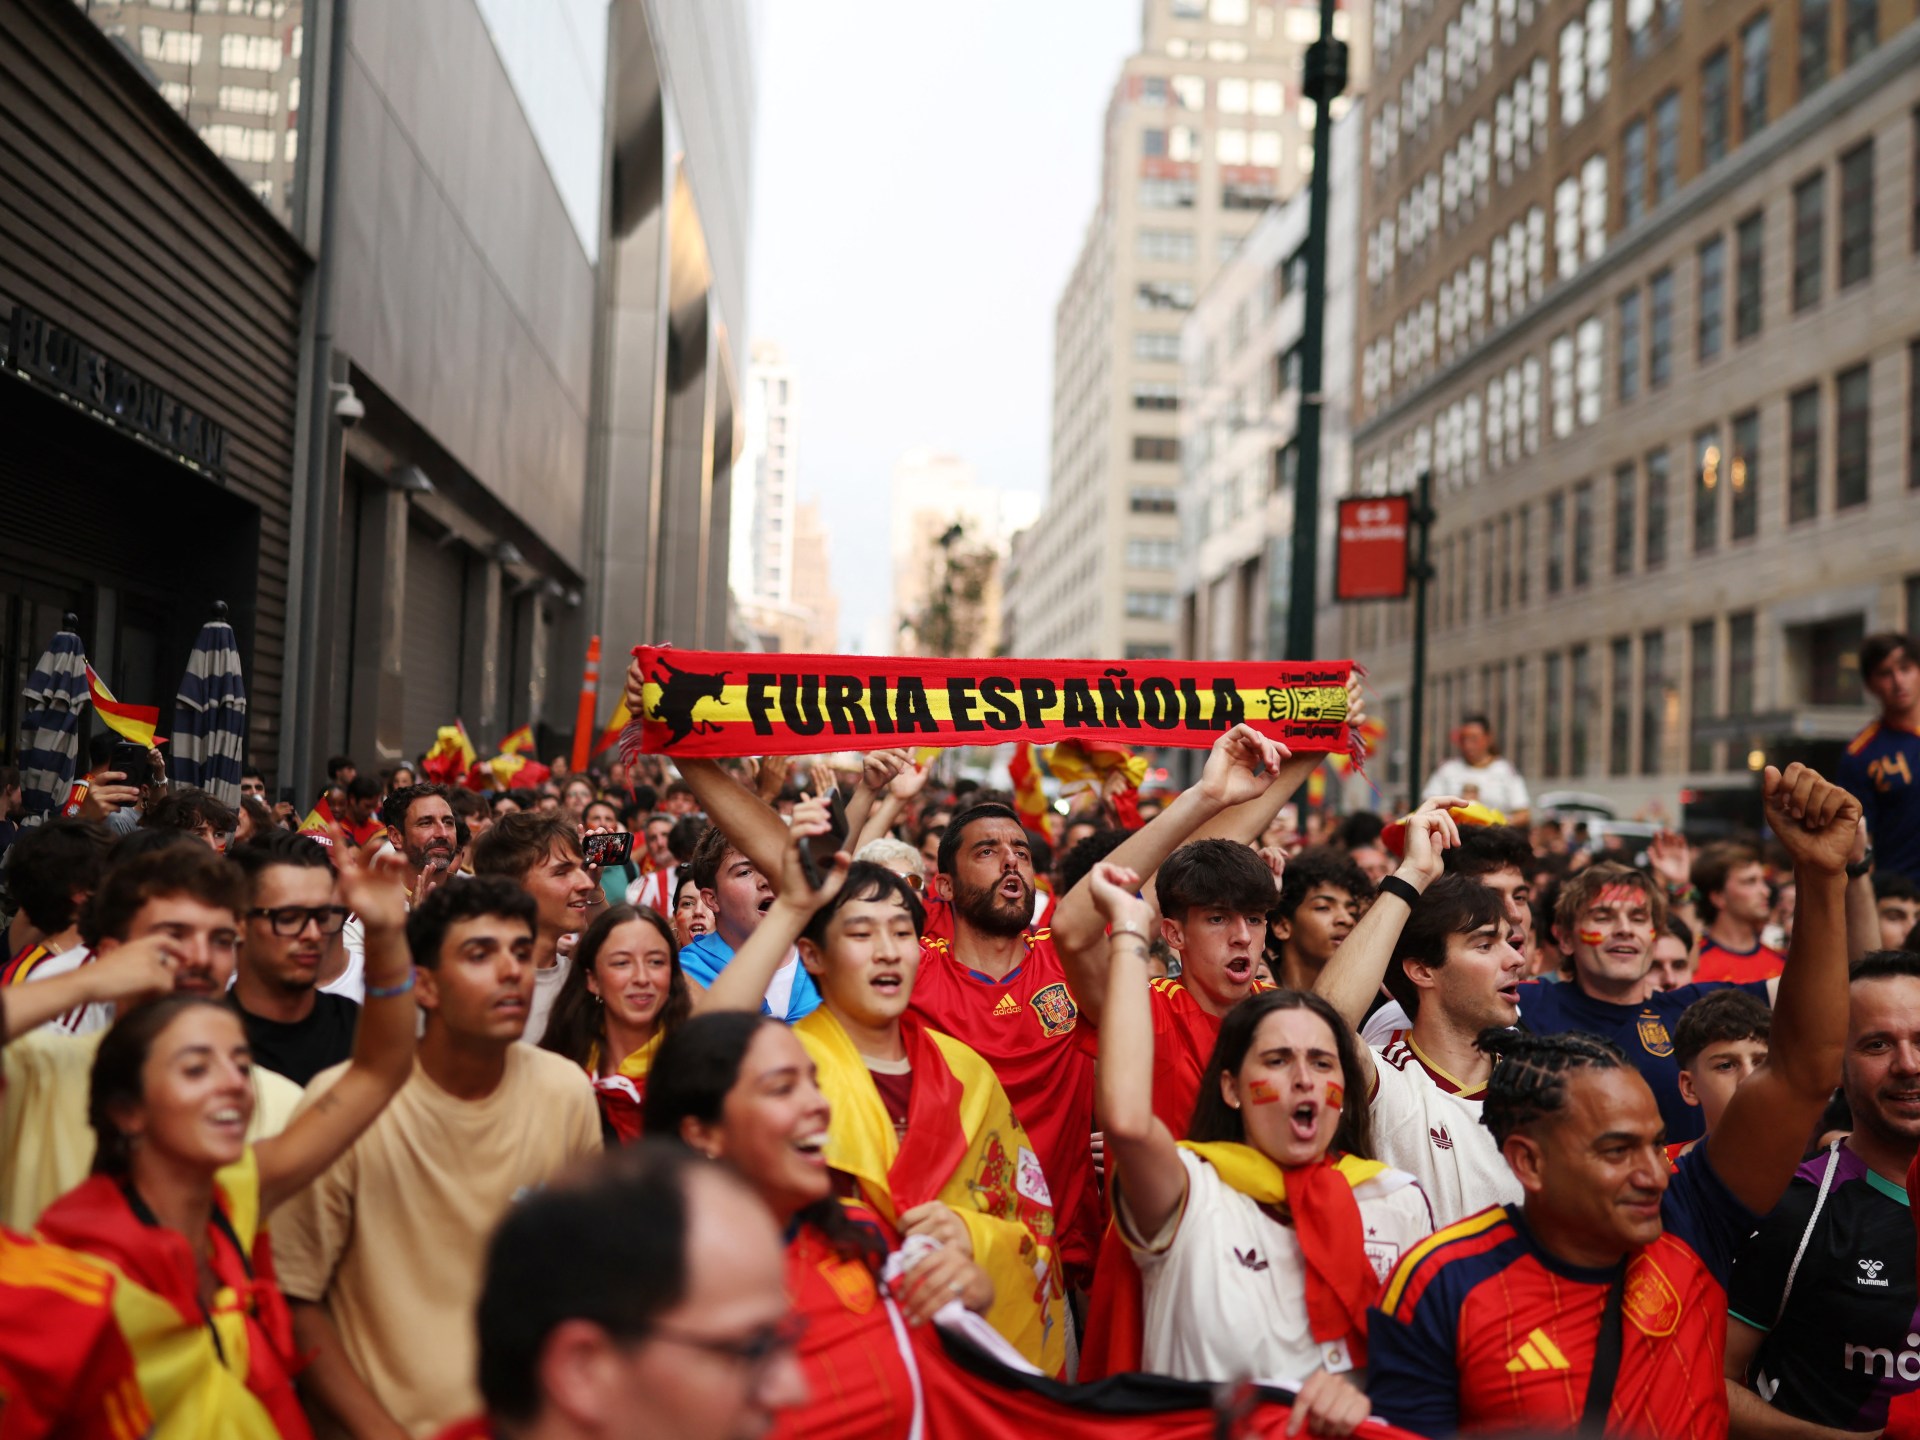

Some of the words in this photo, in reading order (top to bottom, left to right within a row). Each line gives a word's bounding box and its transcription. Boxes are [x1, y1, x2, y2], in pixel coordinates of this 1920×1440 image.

[747, 673, 939, 736] FURIA
[946, 668, 1245, 732] ESPAÑOLA
[1867, 751, 1912, 792] 24
[992, 1004, 1022, 1017] adidas
[1856, 1276, 1889, 1287] hummel
